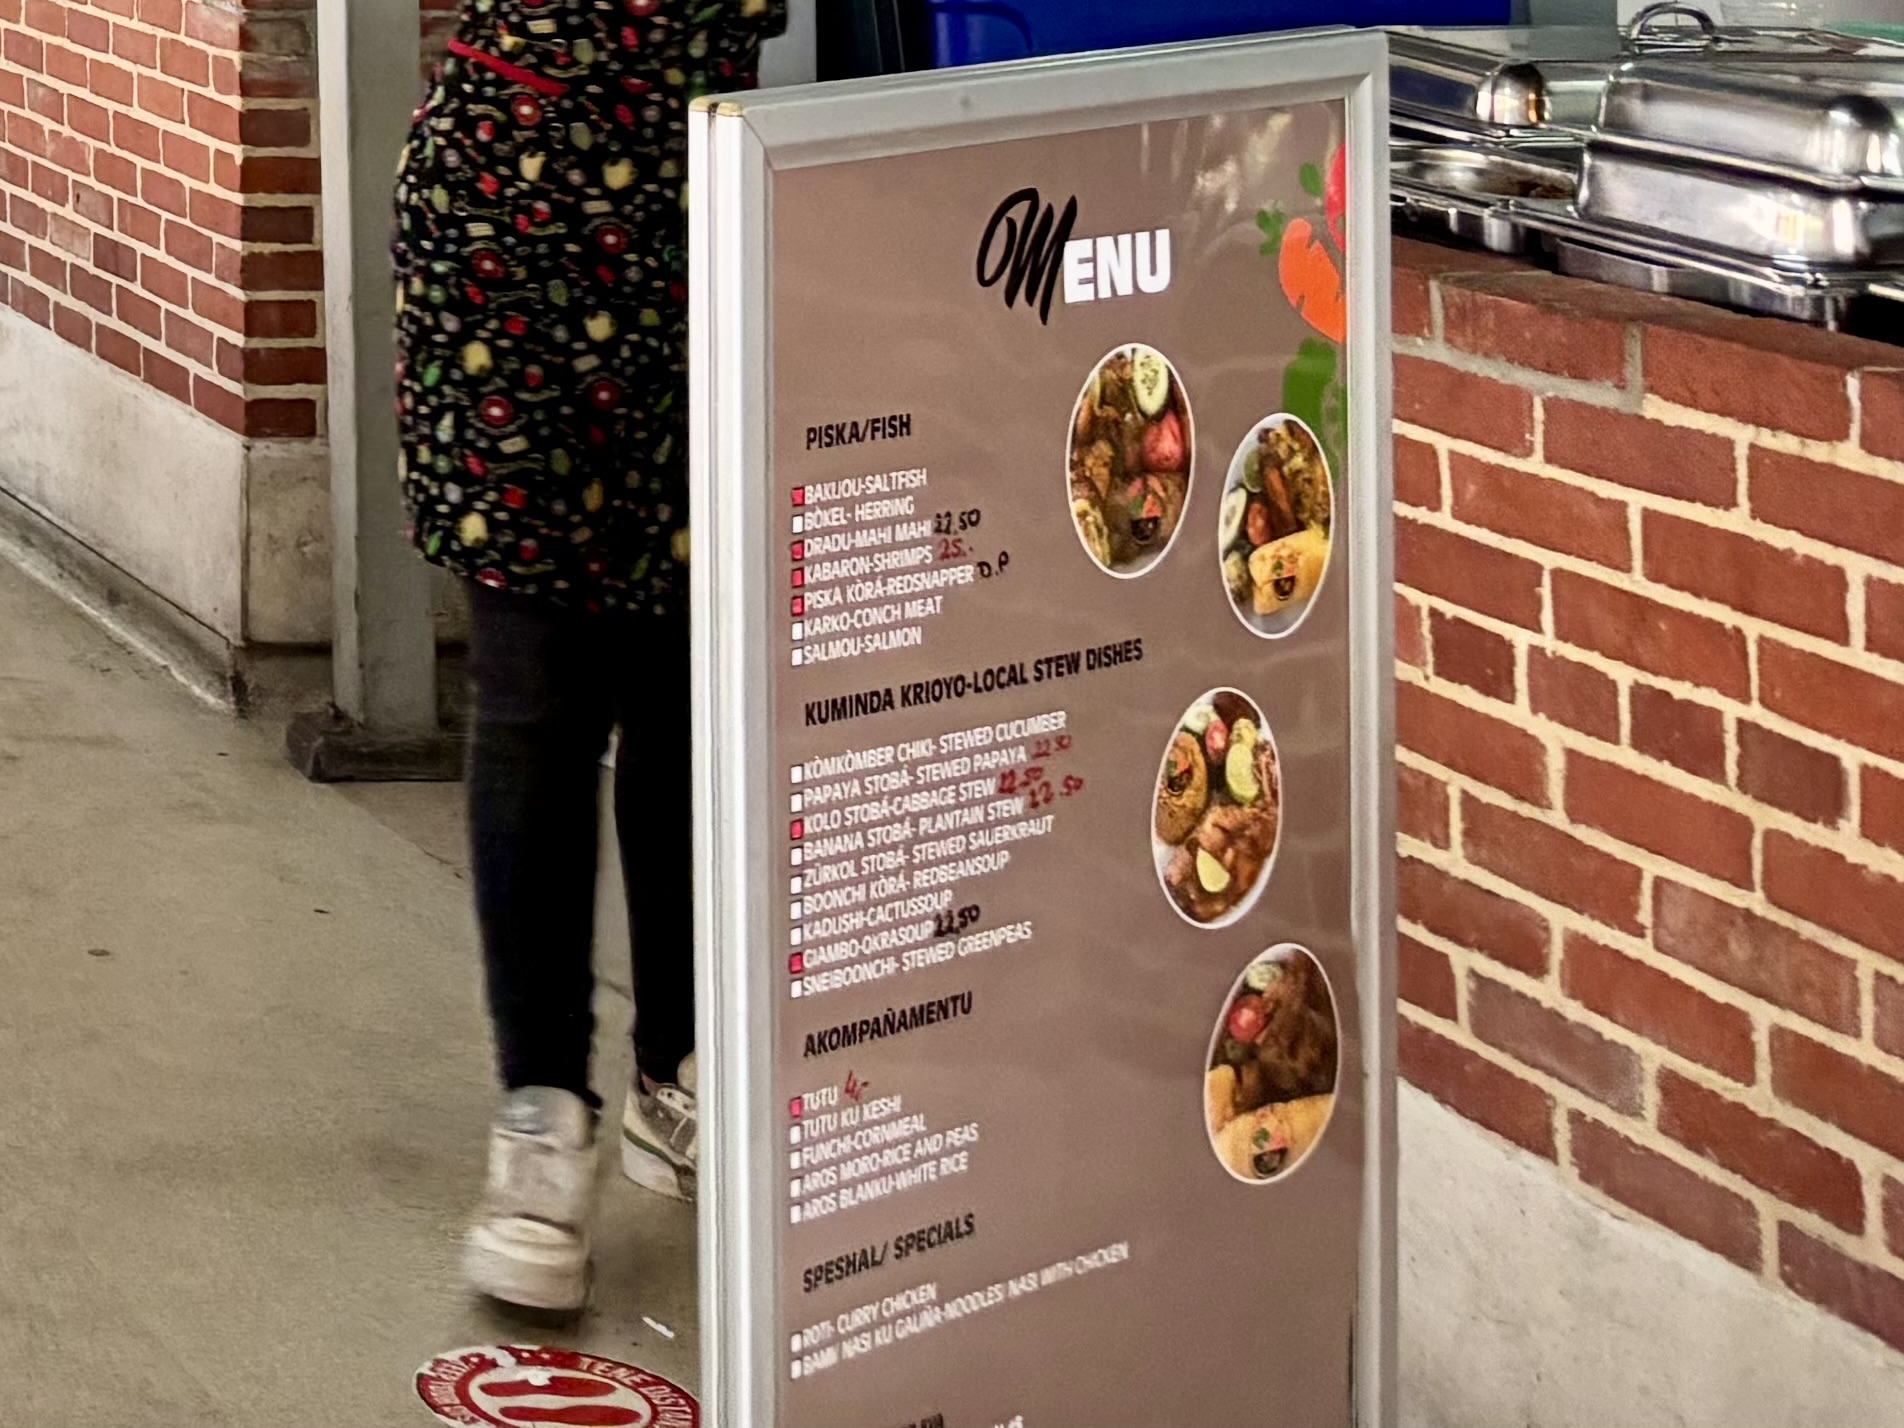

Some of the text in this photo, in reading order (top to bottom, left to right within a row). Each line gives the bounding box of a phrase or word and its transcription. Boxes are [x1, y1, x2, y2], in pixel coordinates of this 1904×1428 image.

[975, 186, 1172, 326] MENU
[805, 413, 912, 451] PISKA/FISH
[854, 495, 915, 523] HERRING
[804, 519, 932, 558] DRADU-MAHI MAHI
[804, 544, 934, 585] KABARON-SHRIMPS
[803, 595, 944, 639] KARKO-CONCH MEAT
[804, 586, 843, 612] PISKA
[803, 625, 923, 665] SALMOU-SALMON
[804, 637, 1145, 727] KUMINDA KRIOYO-LOCAL STEW DISHES
[939, 725, 994, 754] STEWED
[995, 710, 1067, 743] CUCUMBER
[803, 778, 862, 808] PAPAYA
[916, 756, 971, 785] STEWED
[973, 745, 1028, 773] PAPAYA
[803, 809, 842, 834] KOLO
[958, 777, 997, 802] STEW
[803, 830, 864, 861] BANANA
[918, 804, 985, 836] PLANTAIN
[987, 796, 1025, 821] STEW
[911, 835, 967, 865] STEWED
[968, 814, 1055, 851] SAUERKRAUT
[803, 883, 866, 916] BOONCHI
[912, 850, 1011, 891] REDBEANSOUP
[803, 889, 954, 942] KADUSHI-CACTUSSOUP
[803, 919, 935, 969] GIAMBO-OKRASOUP
[902, 939, 955, 972] STEWED
[957, 920, 1033, 957] GREENPEAS
[803, 990, 973, 1059] AKOMPAÑAMENTU
[802, 1085, 839, 1112] TUTU
[802, 1094, 903, 1140] TUTU KU KESHI
[802, 1113, 928, 1167] FUNCHI-CORNMEAL
[802, 1122, 980, 1194] AROS MORO-RICE AND PEAS
[802, 1192, 838, 1221] AROS
[939, 1150, 970, 1177] RICE
[803, 1212, 975, 1293] SPESHAL/ SPECIALS
